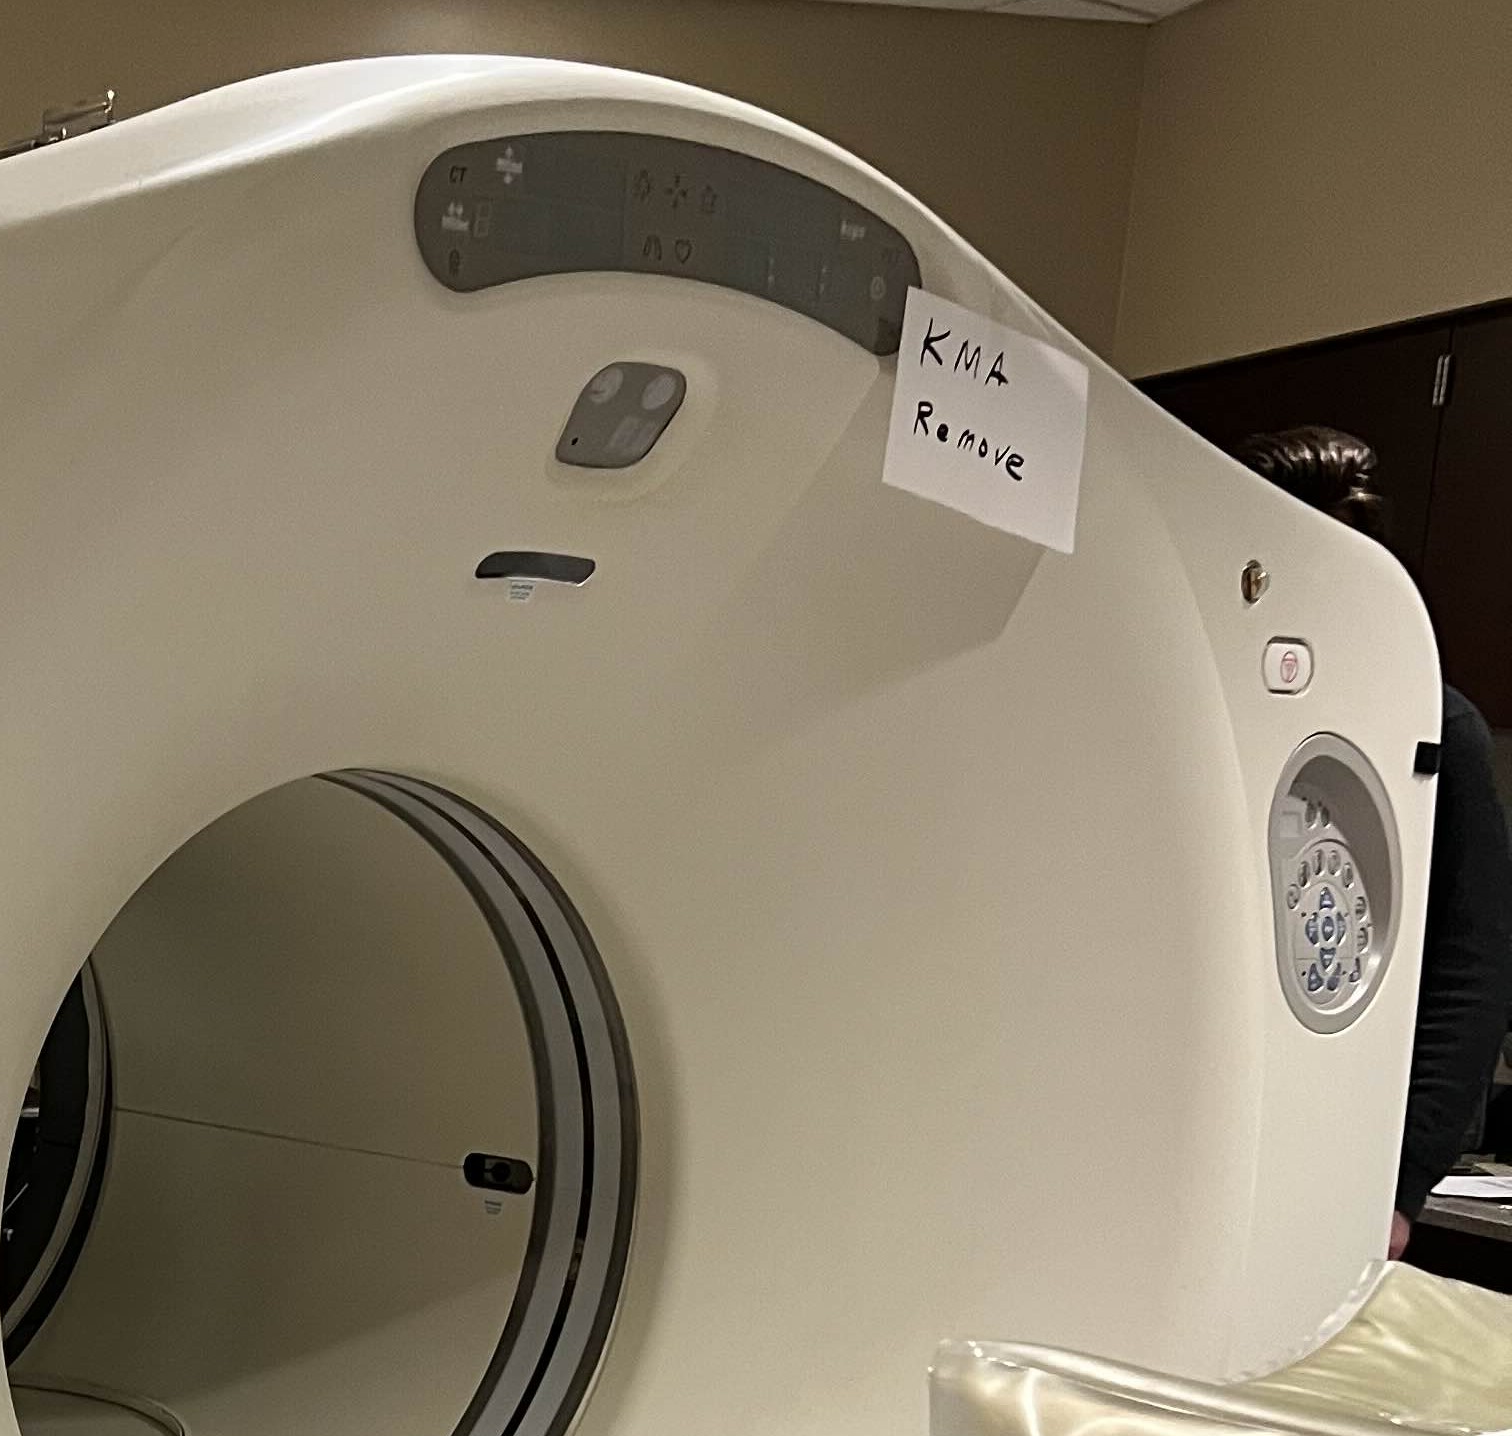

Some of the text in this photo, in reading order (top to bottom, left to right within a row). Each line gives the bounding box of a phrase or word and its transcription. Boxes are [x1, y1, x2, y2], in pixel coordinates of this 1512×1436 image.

[449, 165, 467, 183] CT
[919, 317, 1009, 387] KMA
[913, 400, 1025, 481] Remove
